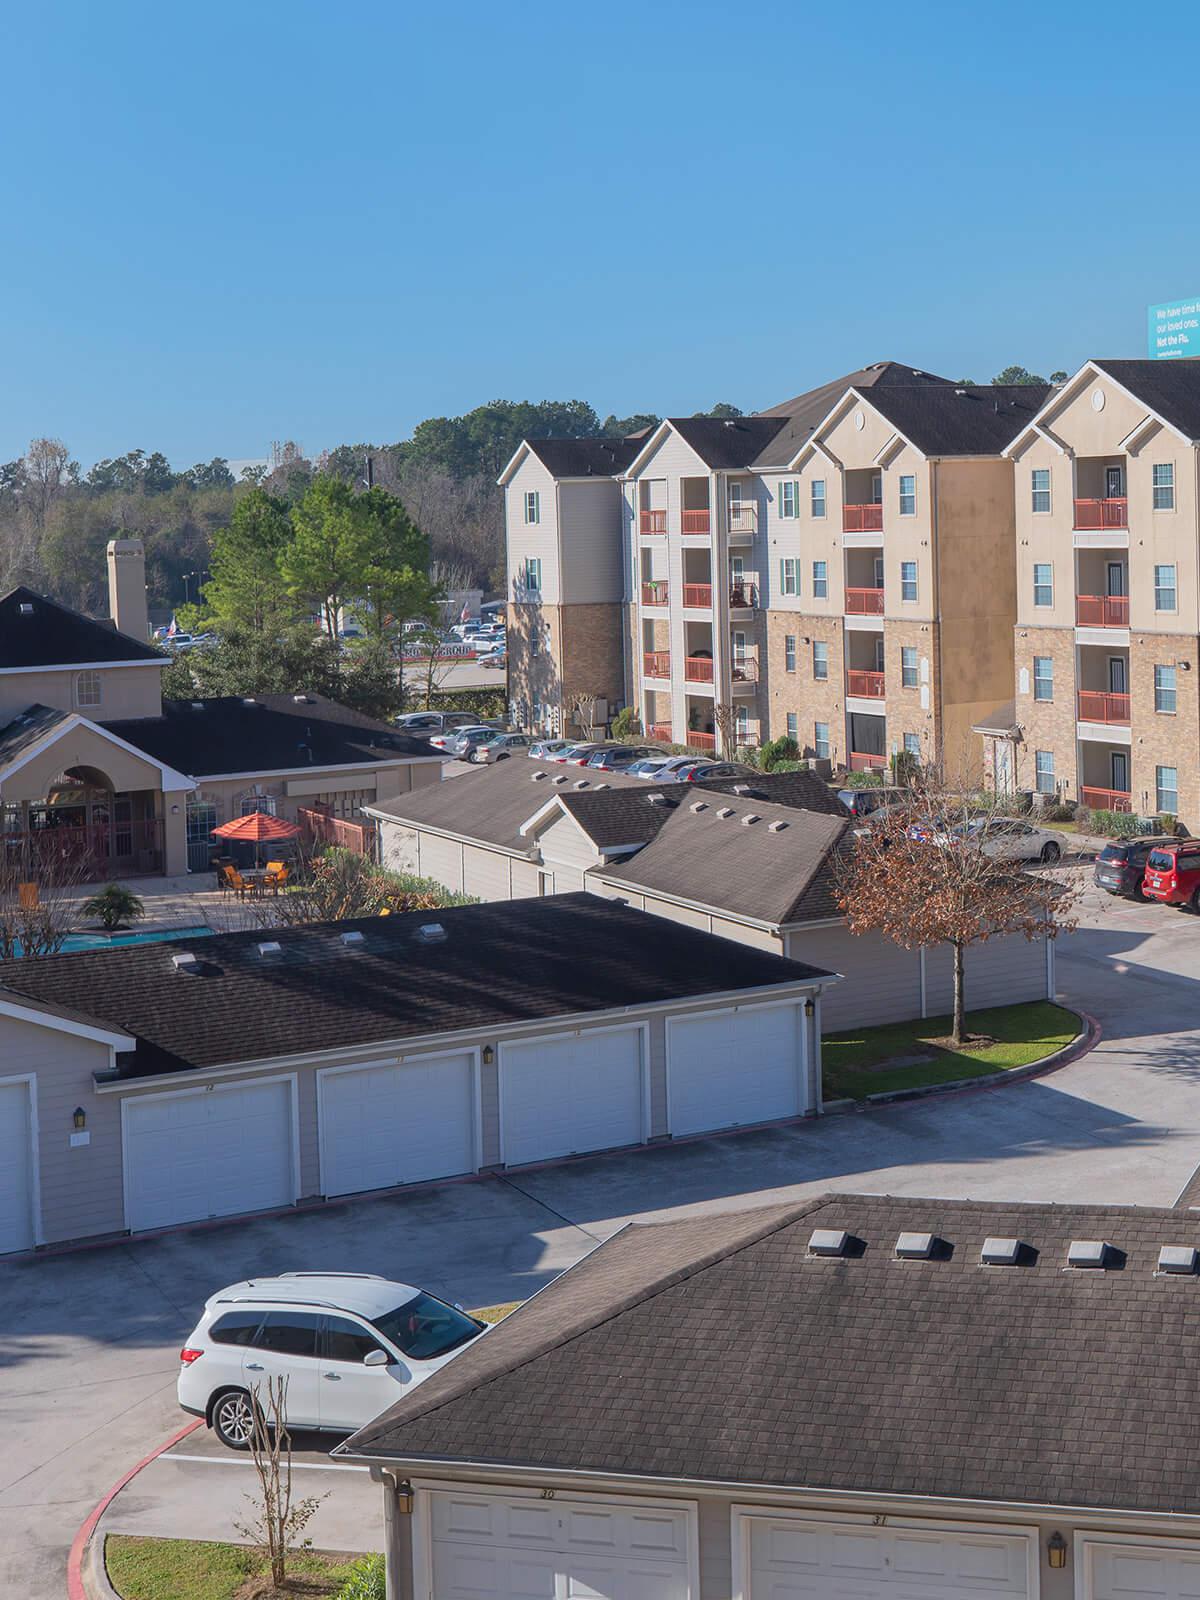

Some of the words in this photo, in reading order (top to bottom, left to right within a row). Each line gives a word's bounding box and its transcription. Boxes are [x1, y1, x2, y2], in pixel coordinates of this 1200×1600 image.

[1157, 310, 1166, 319] We
[1168, 308, 1180, 318] have
[1182, 304, 1195, 314] time
[1168, 320, 1183, 331] loved
[1157, 337, 1168, 347] Not
[1168, 336, 1178, 346] the
[541, 1488, 554, 1500] 30
[872, 1514, 887, 1526] 31
